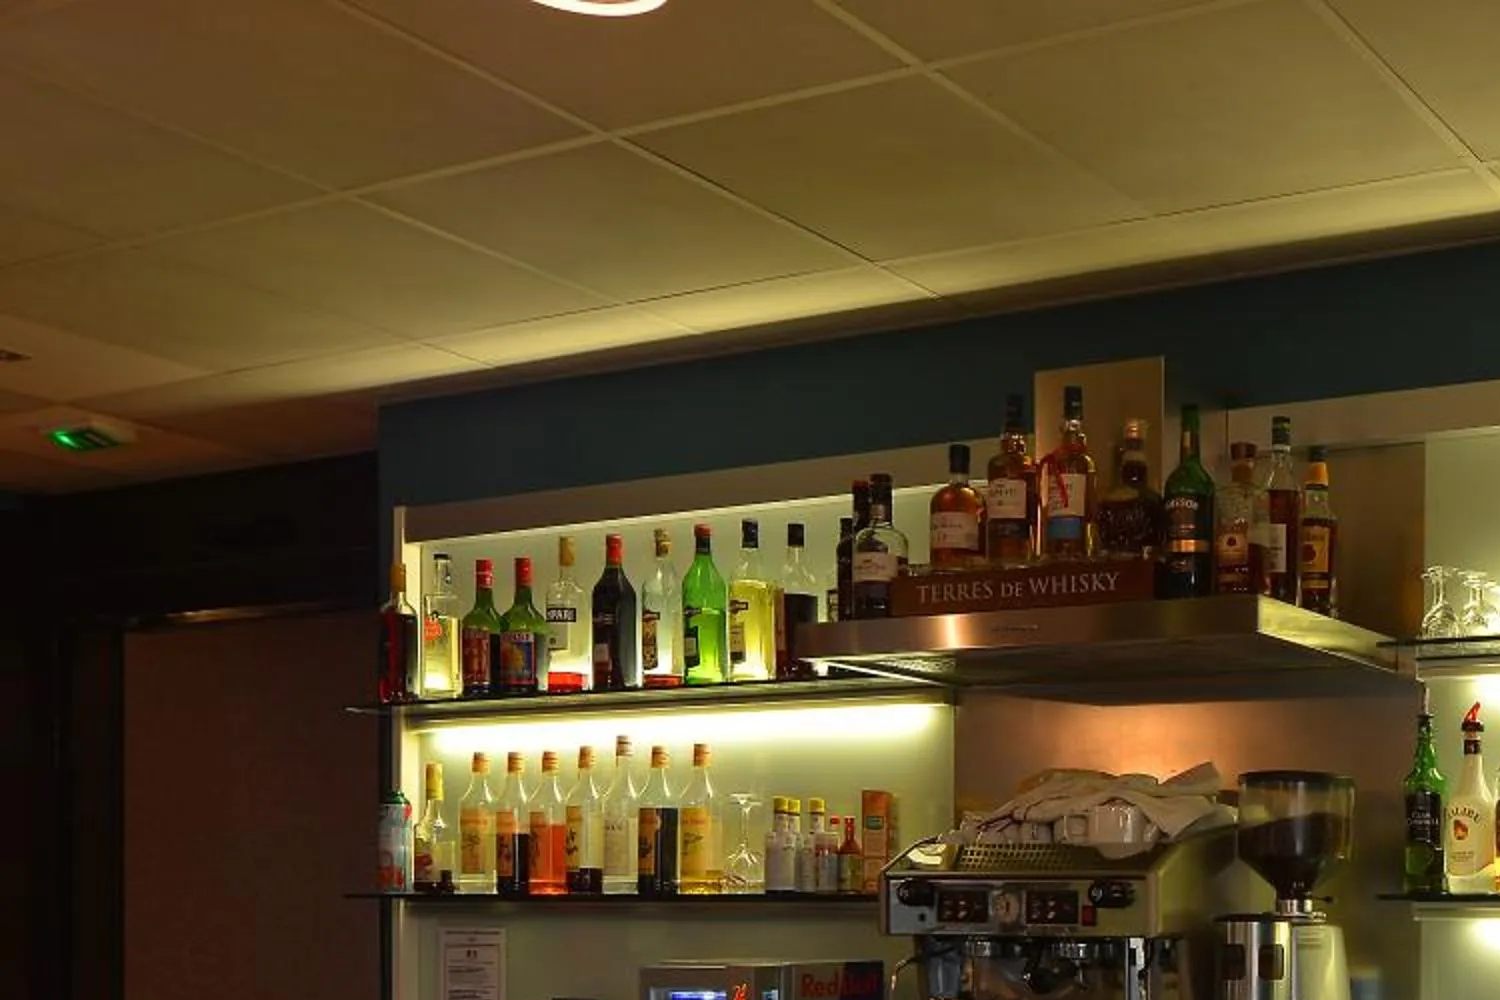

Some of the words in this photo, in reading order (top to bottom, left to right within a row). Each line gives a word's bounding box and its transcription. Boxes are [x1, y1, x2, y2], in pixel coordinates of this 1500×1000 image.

[916, 581, 994, 604] TERRES
[1000, 582, 1024, 598] DE
[1030, 571, 1121, 596] WHISKY
[801, 969, 838, 998] Red
